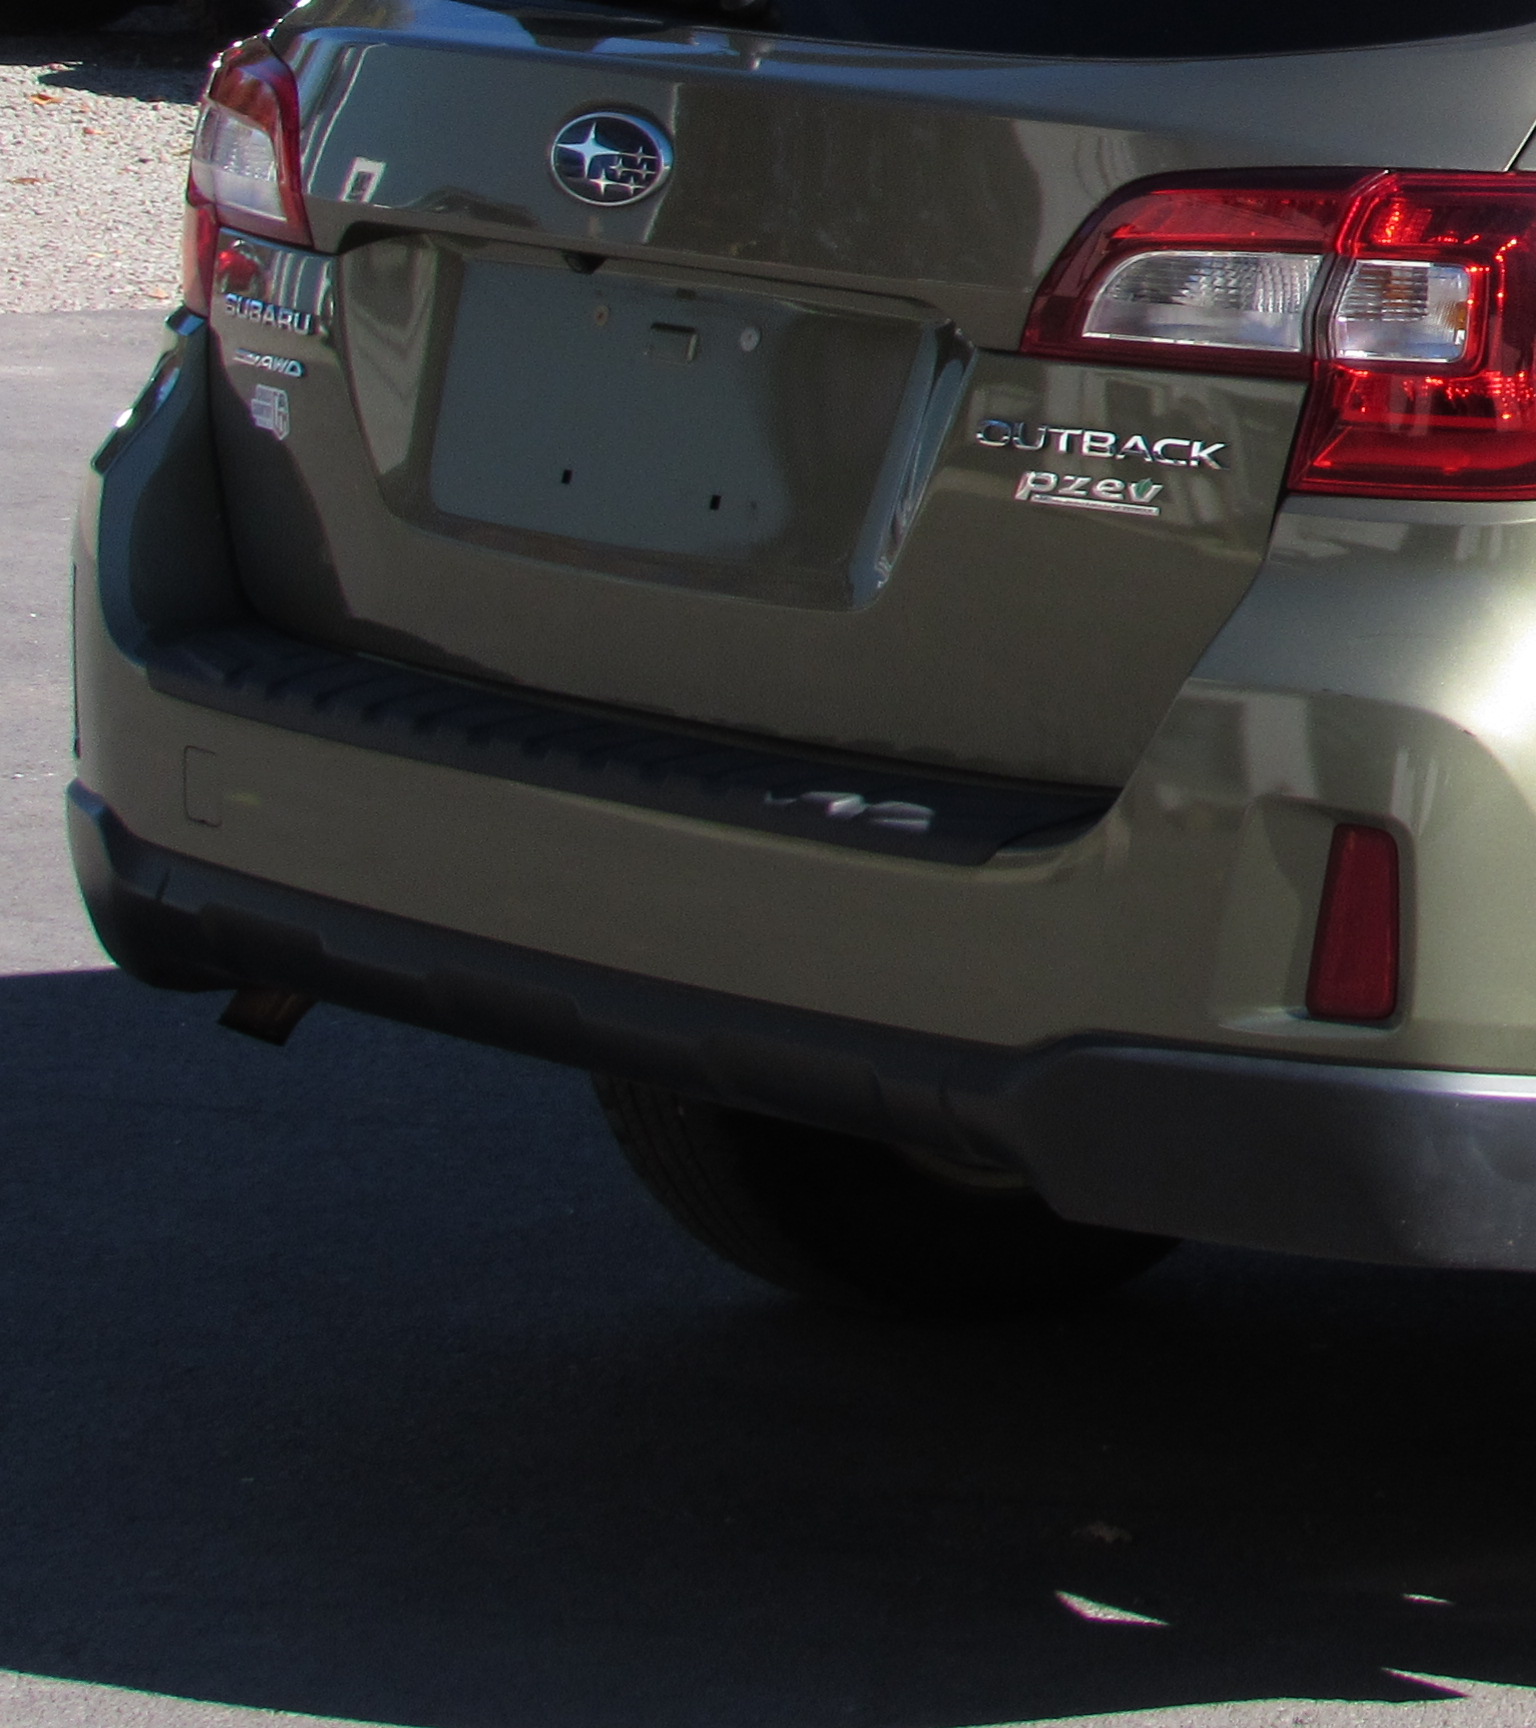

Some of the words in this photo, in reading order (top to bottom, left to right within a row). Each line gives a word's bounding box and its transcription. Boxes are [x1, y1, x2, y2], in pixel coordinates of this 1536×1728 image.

[224, 293, 312, 335] SUBARU
[257, 355, 303, 376] AWD
[975, 419, 1229, 470] OUTBACK
[1014, 470, 1165, 504] pzev
